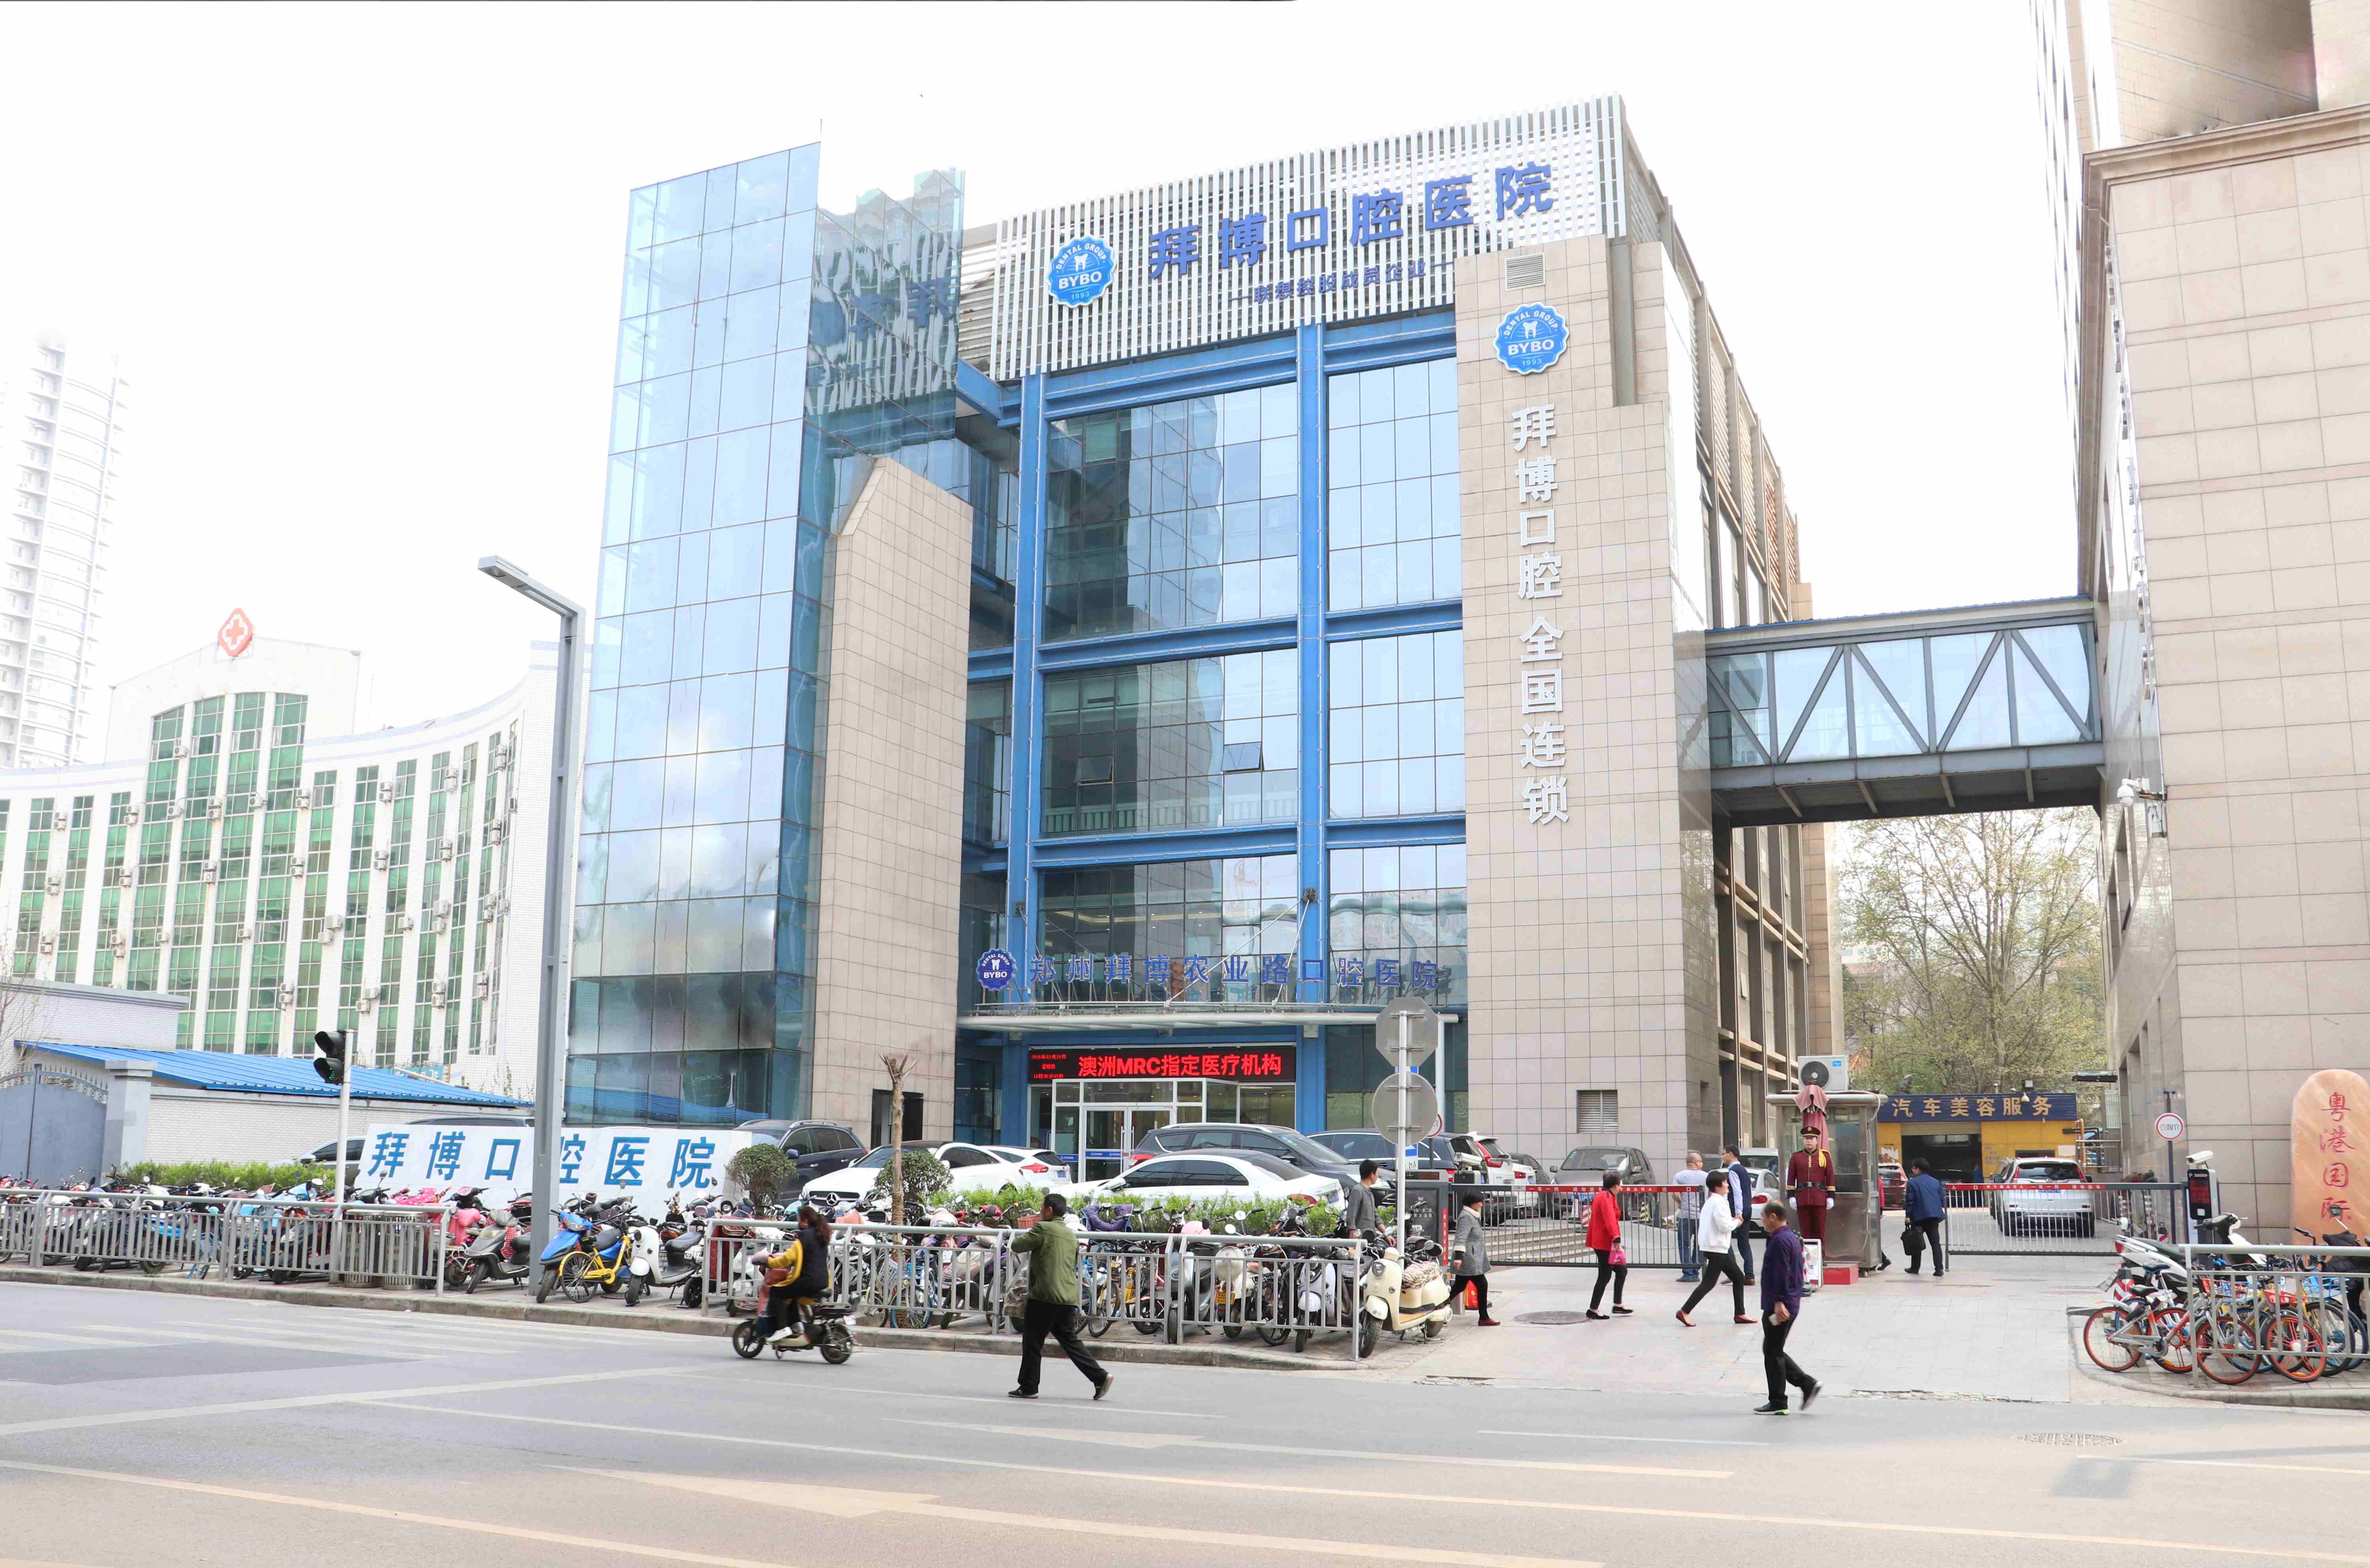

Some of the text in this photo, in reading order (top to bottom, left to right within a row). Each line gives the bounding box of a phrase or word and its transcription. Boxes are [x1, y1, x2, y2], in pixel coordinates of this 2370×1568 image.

[1148, 161, 1556, 280] 拜博口腔医院
[1056, 243, 1106, 270] DENTAL GROUP
[1059, 271, 1102, 289] BYBO
[1071, 291, 1090, 299] 1993
[1503, 310, 1558, 335] DENTAL GROUP
[1508, 339, 1555, 355] BYBO
[982, 953, 1010, 966] DENTAL GROUP
[1030, 953, 1439, 990] 郑州拜博农业路口腔医院
[1078, 1053, 1282, 1077] 澳洲MRC指定医疗机构
[1892, 1096, 2052, 1117] 汽车美容服务
[367, 1131, 715, 1189] 拜博口腔医院
[2320, 1092, 2357, 1221] 粤港国际
